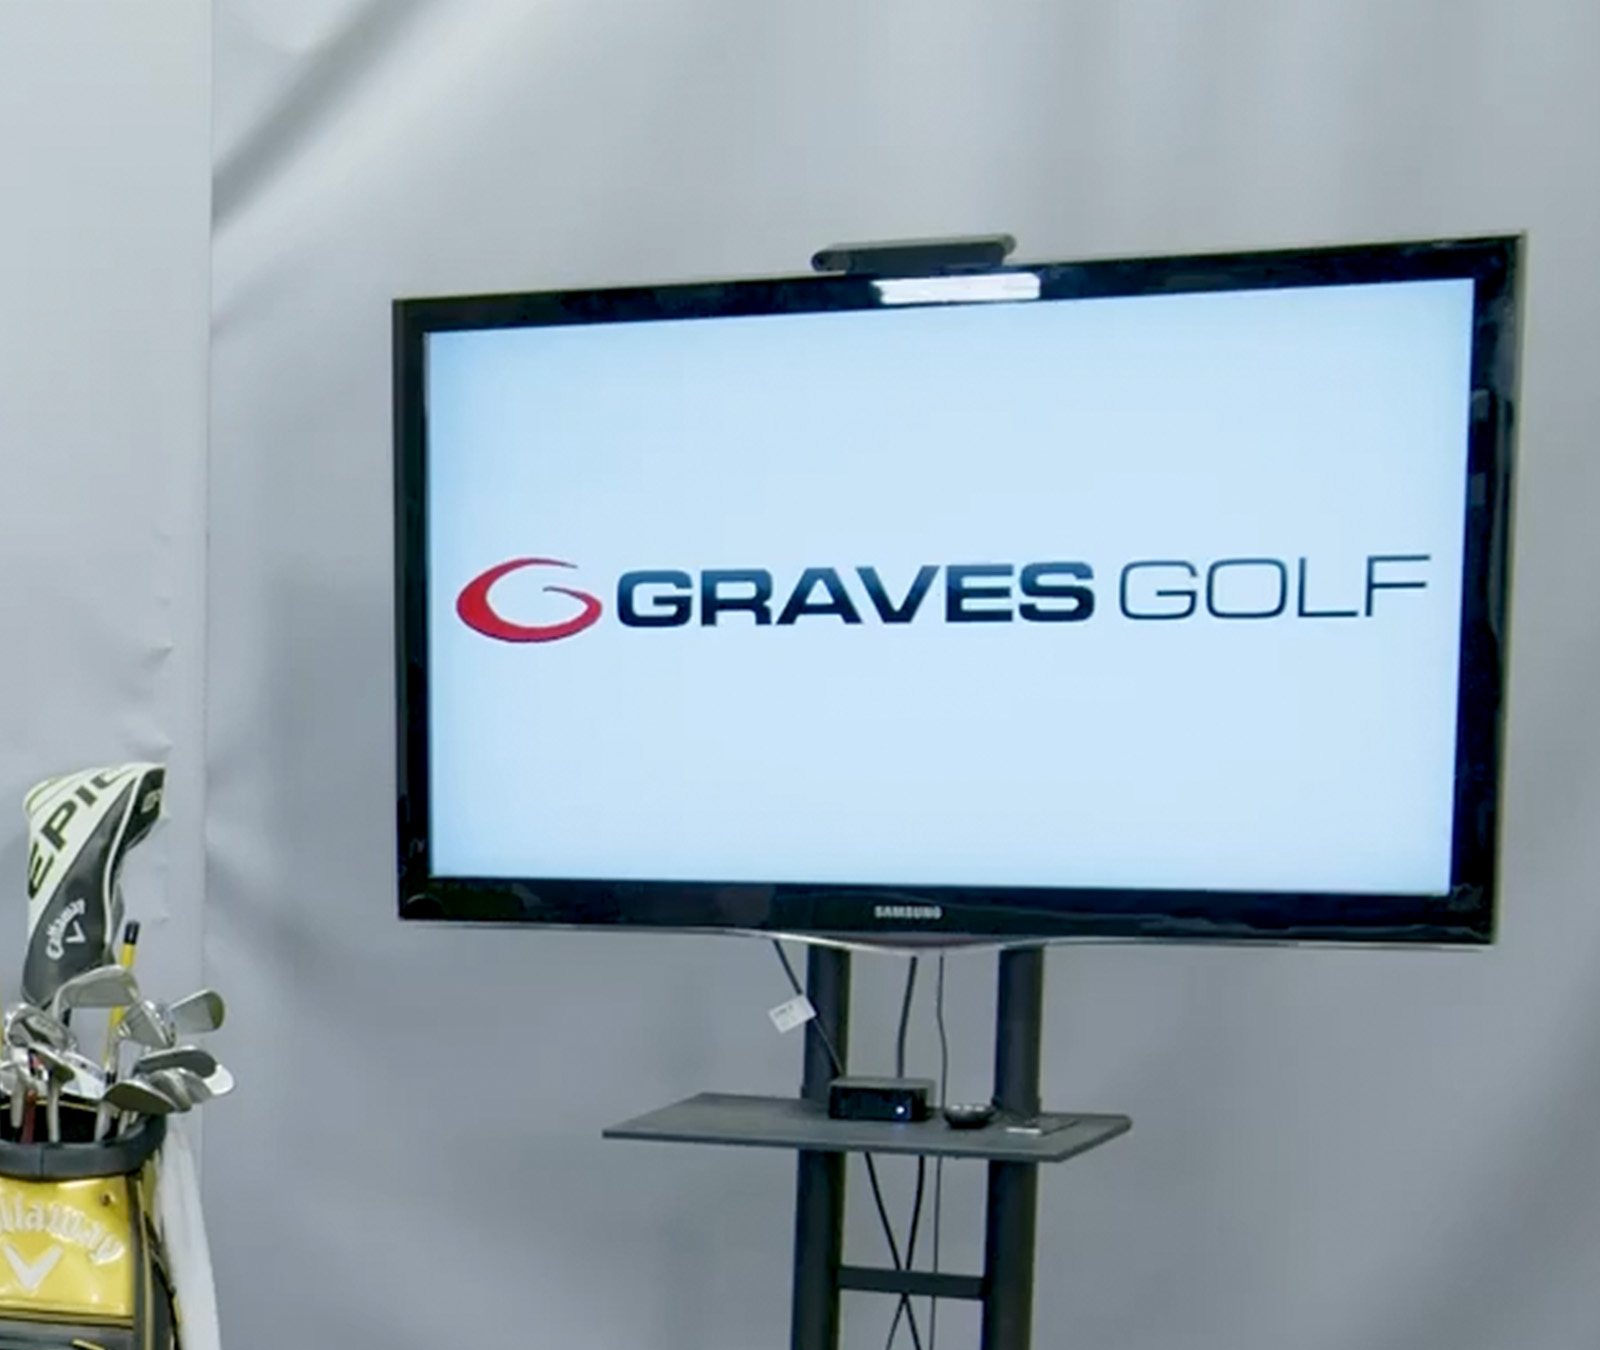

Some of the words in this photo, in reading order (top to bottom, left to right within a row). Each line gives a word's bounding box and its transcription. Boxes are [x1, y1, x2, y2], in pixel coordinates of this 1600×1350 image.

[616, 560, 1096, 628] GRAVES
[1119, 555, 1432, 620] GOLF
[46, 898, 86, 960] Callaway
[874, 905, 942, 920] SAMSUNG
